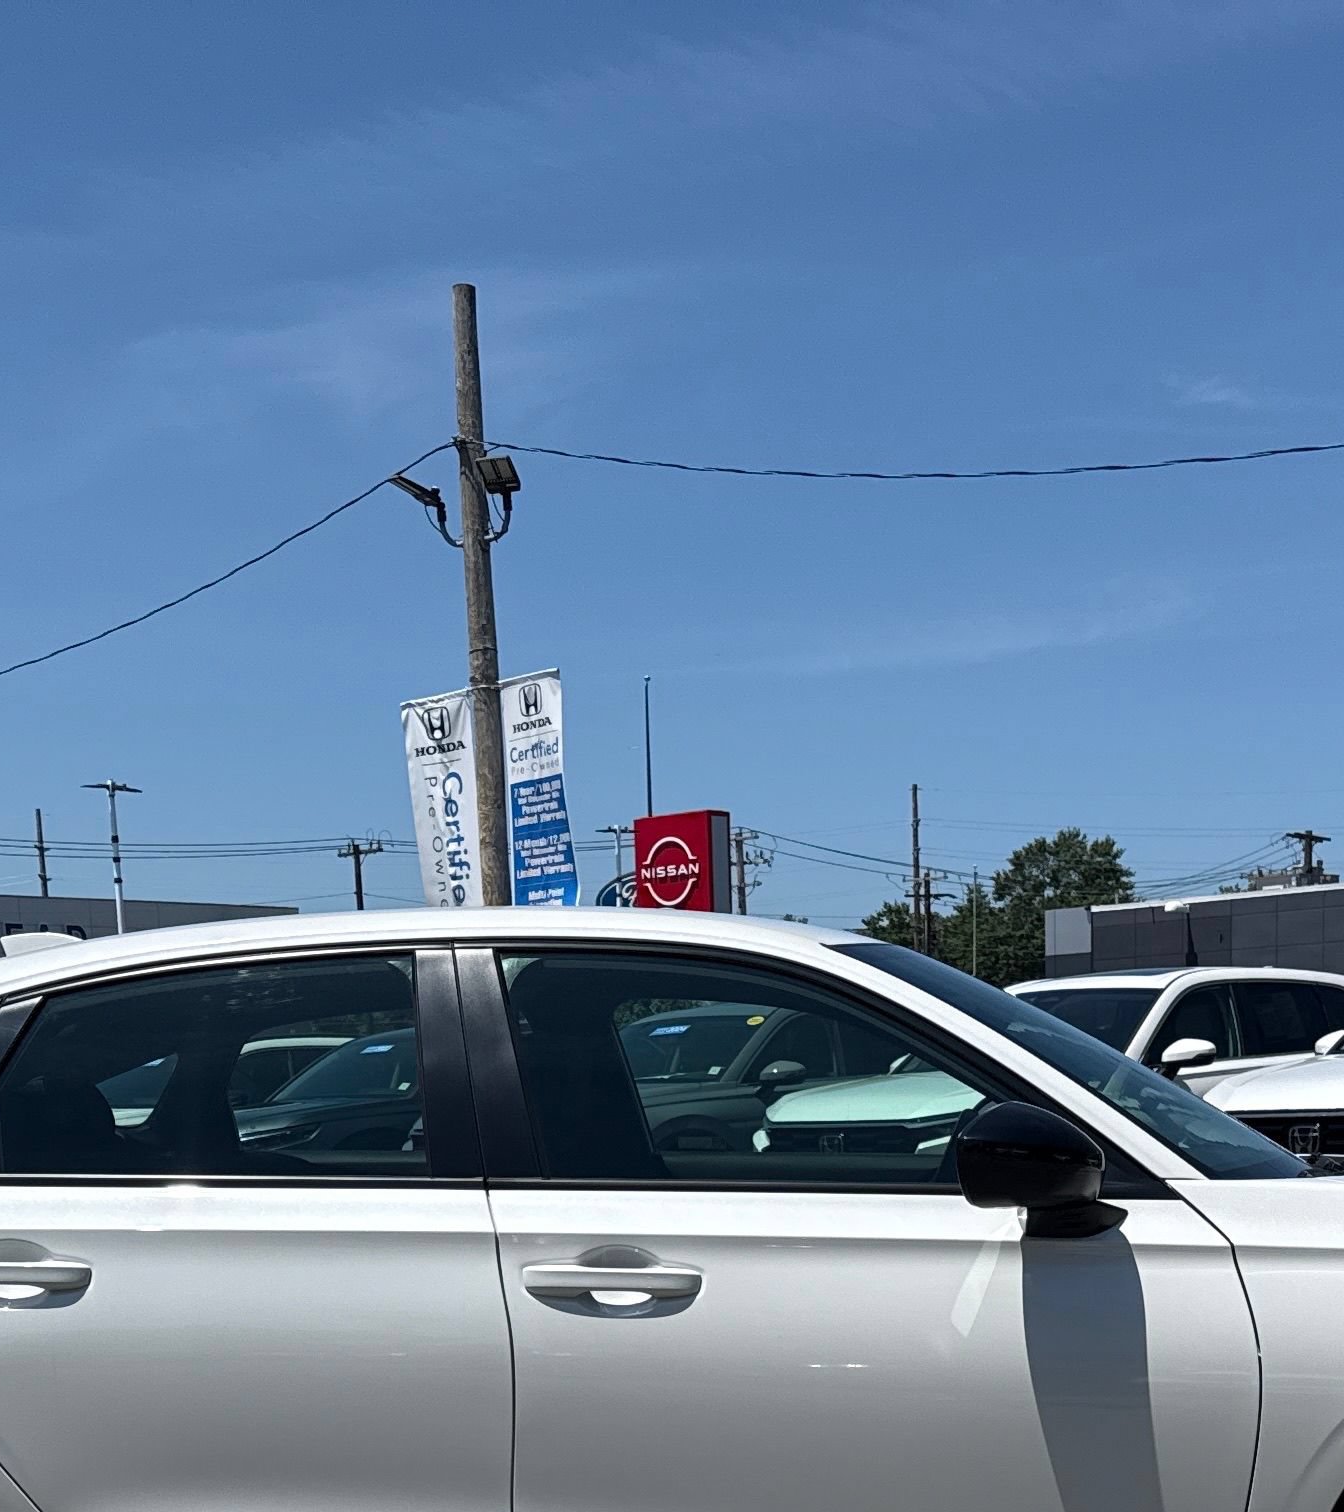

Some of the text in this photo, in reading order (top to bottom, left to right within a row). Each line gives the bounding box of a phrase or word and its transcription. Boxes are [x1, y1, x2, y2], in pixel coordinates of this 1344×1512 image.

[513, 717, 553, 734] HONDA
[414, 740, 467, 758] HONDA
[510, 736, 559, 763] Certified
[424, 776, 449, 907] Pre-Owne
[442, 770, 471, 907] Certifie
[641, 862, 700, 880] NISSAN
